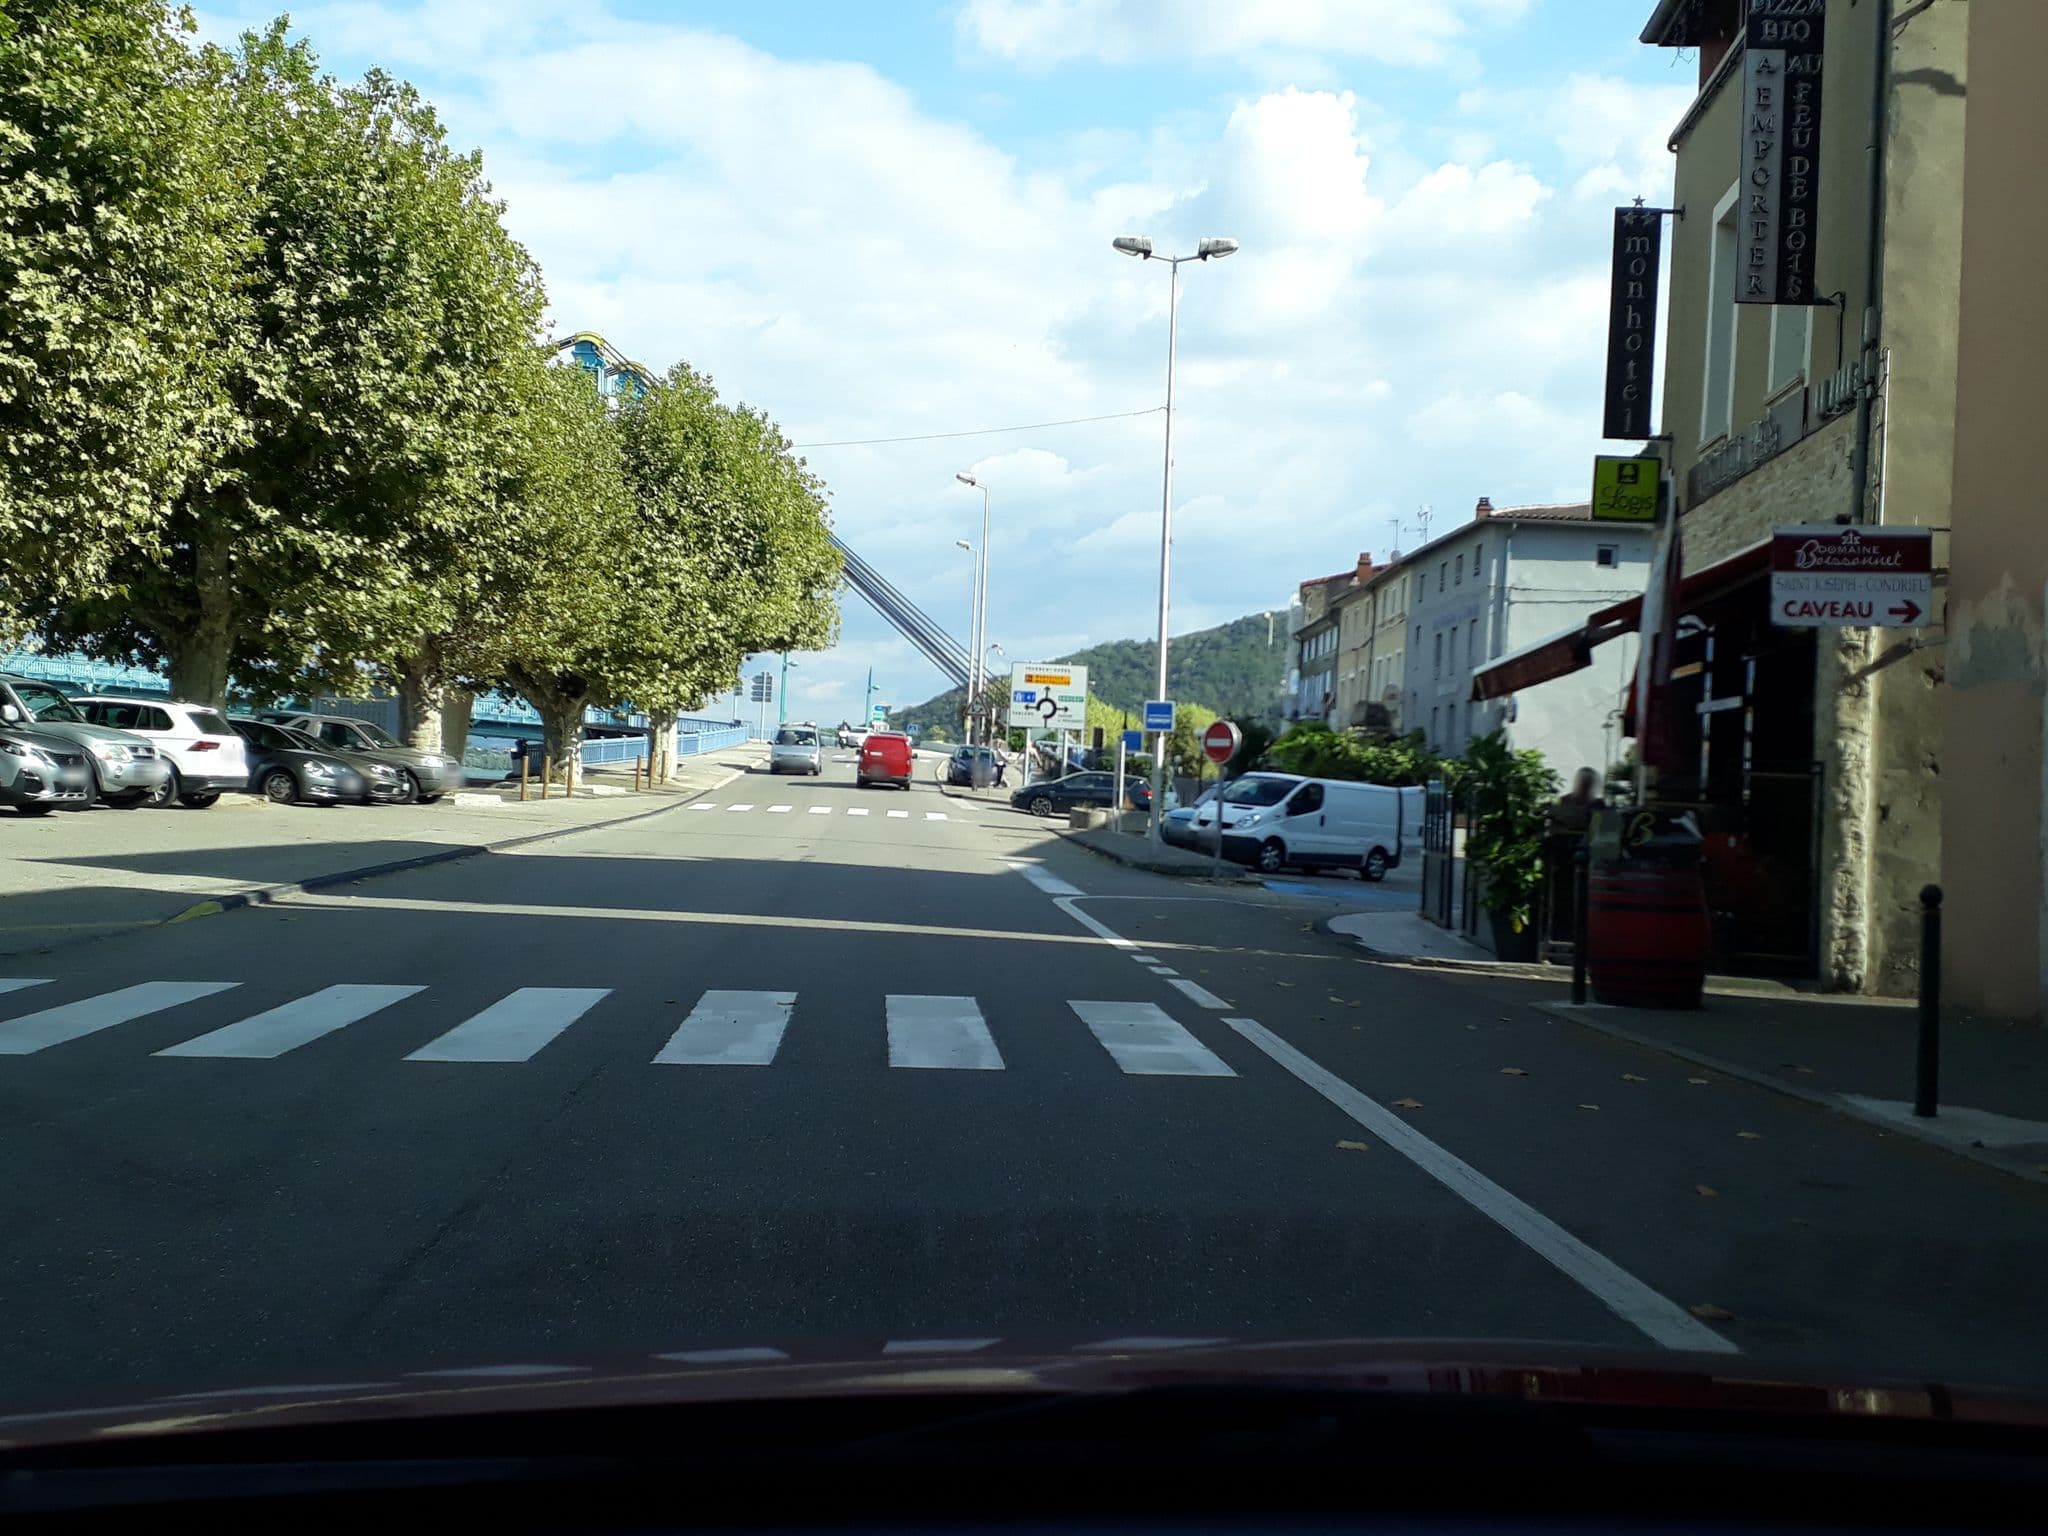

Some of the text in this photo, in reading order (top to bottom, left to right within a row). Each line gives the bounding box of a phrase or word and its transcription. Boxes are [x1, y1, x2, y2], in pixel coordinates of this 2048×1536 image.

[1760, 19, 1810, 41] BIO
[1748, 56, 1777, 294] A EMPORTER
[1785, 54, 1823, 301] AU FEU DE BOIS
[1599, 484, 1656, 515] Logis
[1818, 545, 1880, 555] DOMAINE
[1783, 600, 1874, 618] CAVEAU
